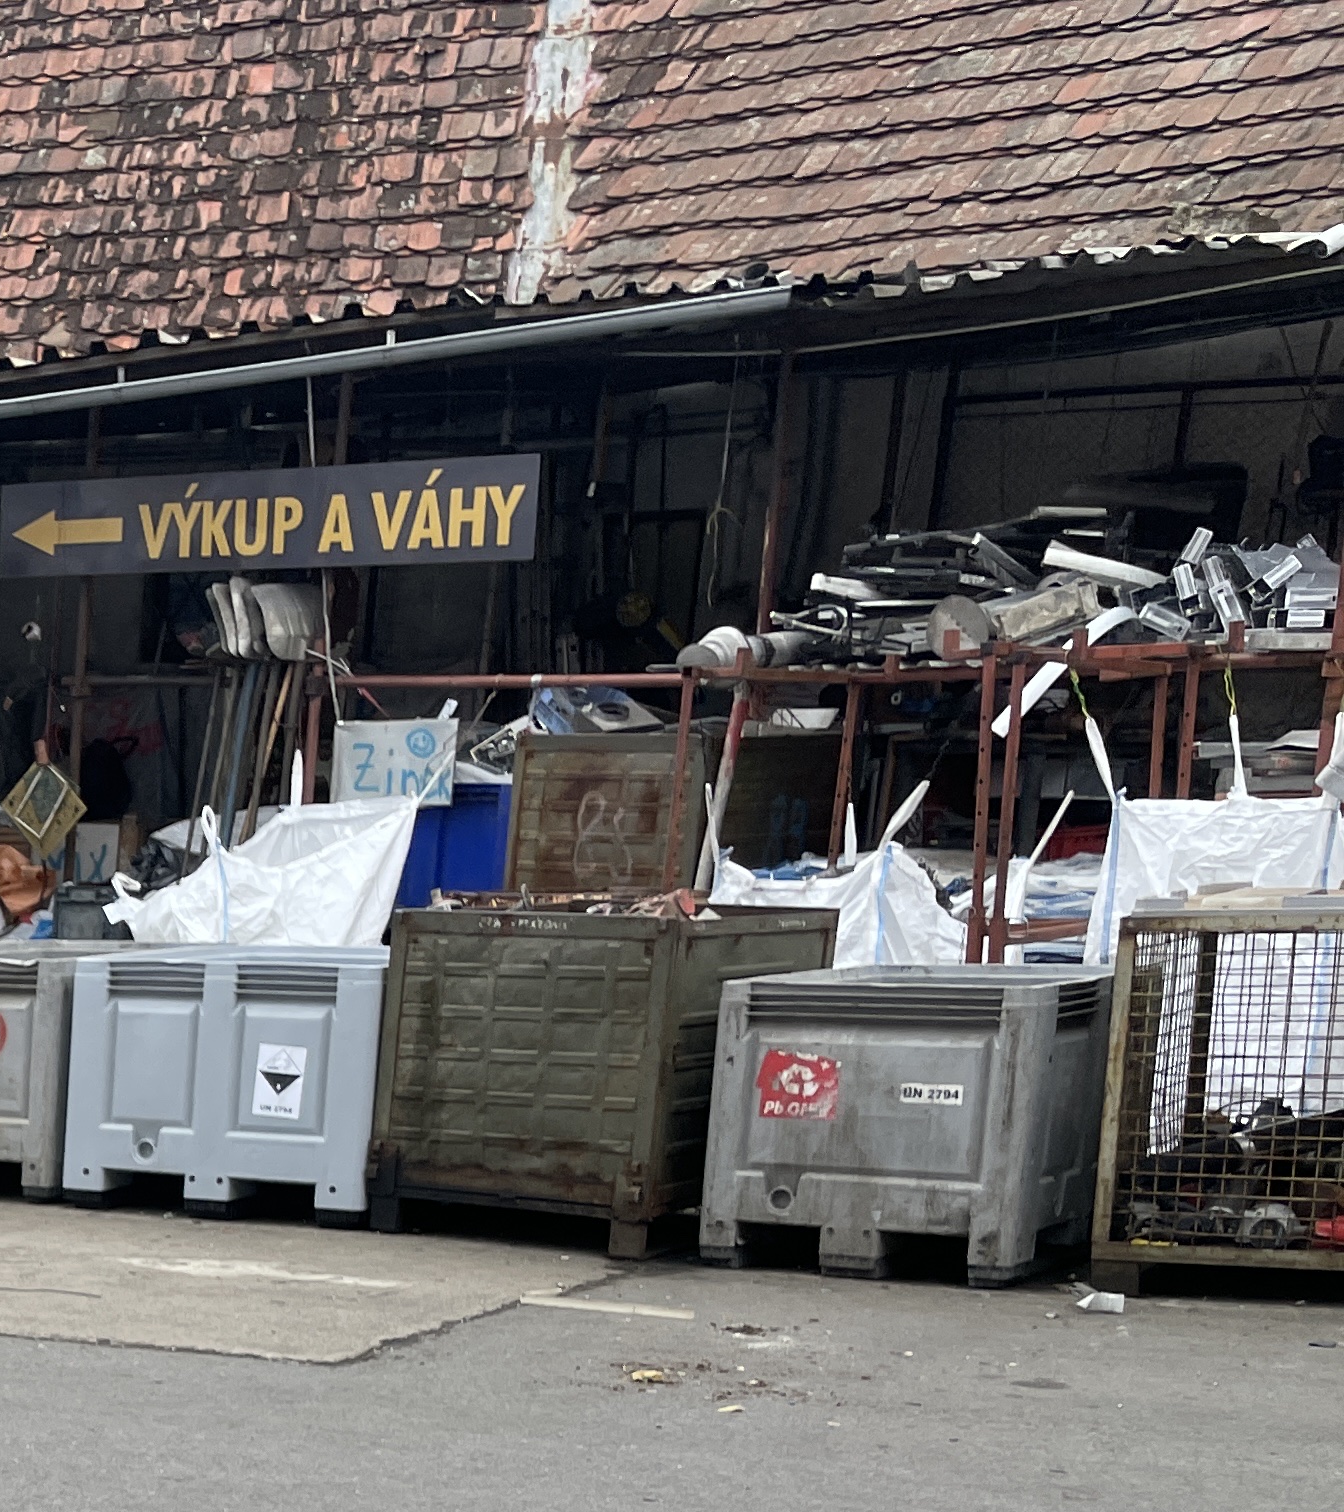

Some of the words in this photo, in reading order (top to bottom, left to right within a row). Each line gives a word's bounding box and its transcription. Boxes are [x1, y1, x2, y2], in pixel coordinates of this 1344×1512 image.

[138, 482, 304, 560] VÝKUP
[317, 493, 355, 554] A
[370, 467, 526, 551] VÁHY
[903, 1086, 923, 1099] UN
